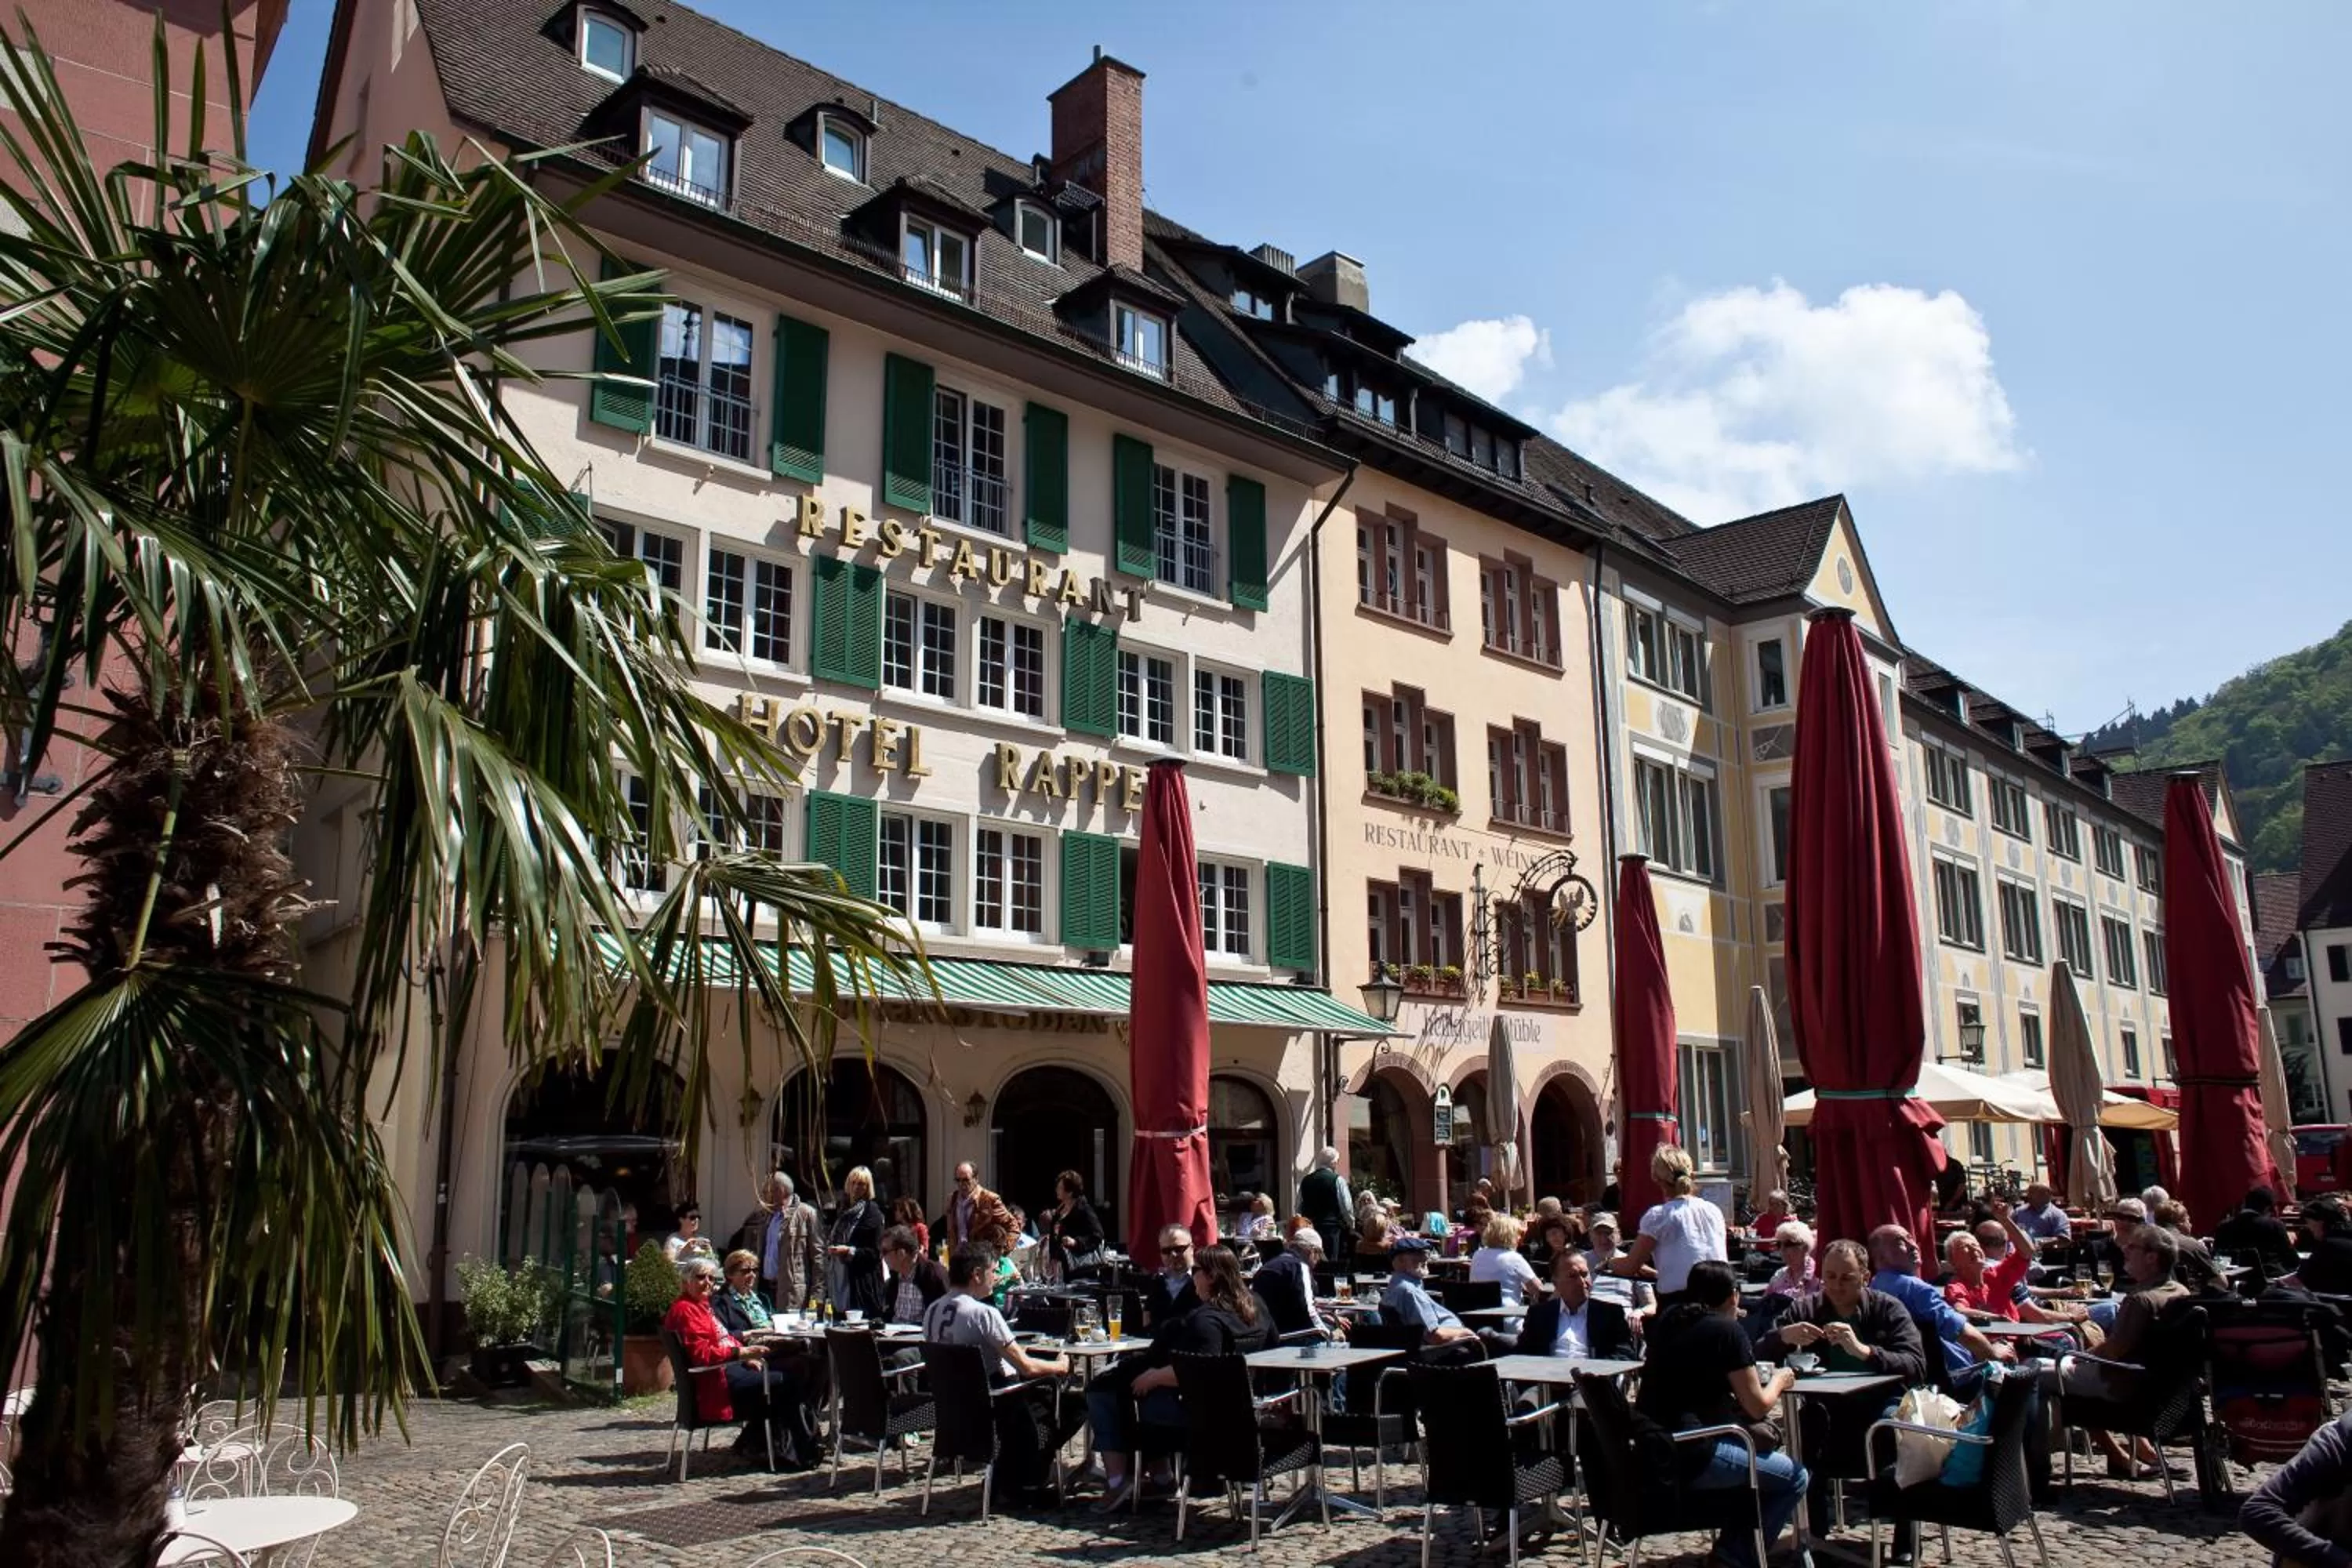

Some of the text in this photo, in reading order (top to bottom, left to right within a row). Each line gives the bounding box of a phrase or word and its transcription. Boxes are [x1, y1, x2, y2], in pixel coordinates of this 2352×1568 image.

[797, 493, 1147, 622] RESTAURANT
[736, 691, 1143, 811] HOTEL RAPPE
[1364, 822, 1472, 859] RESTAURANT
